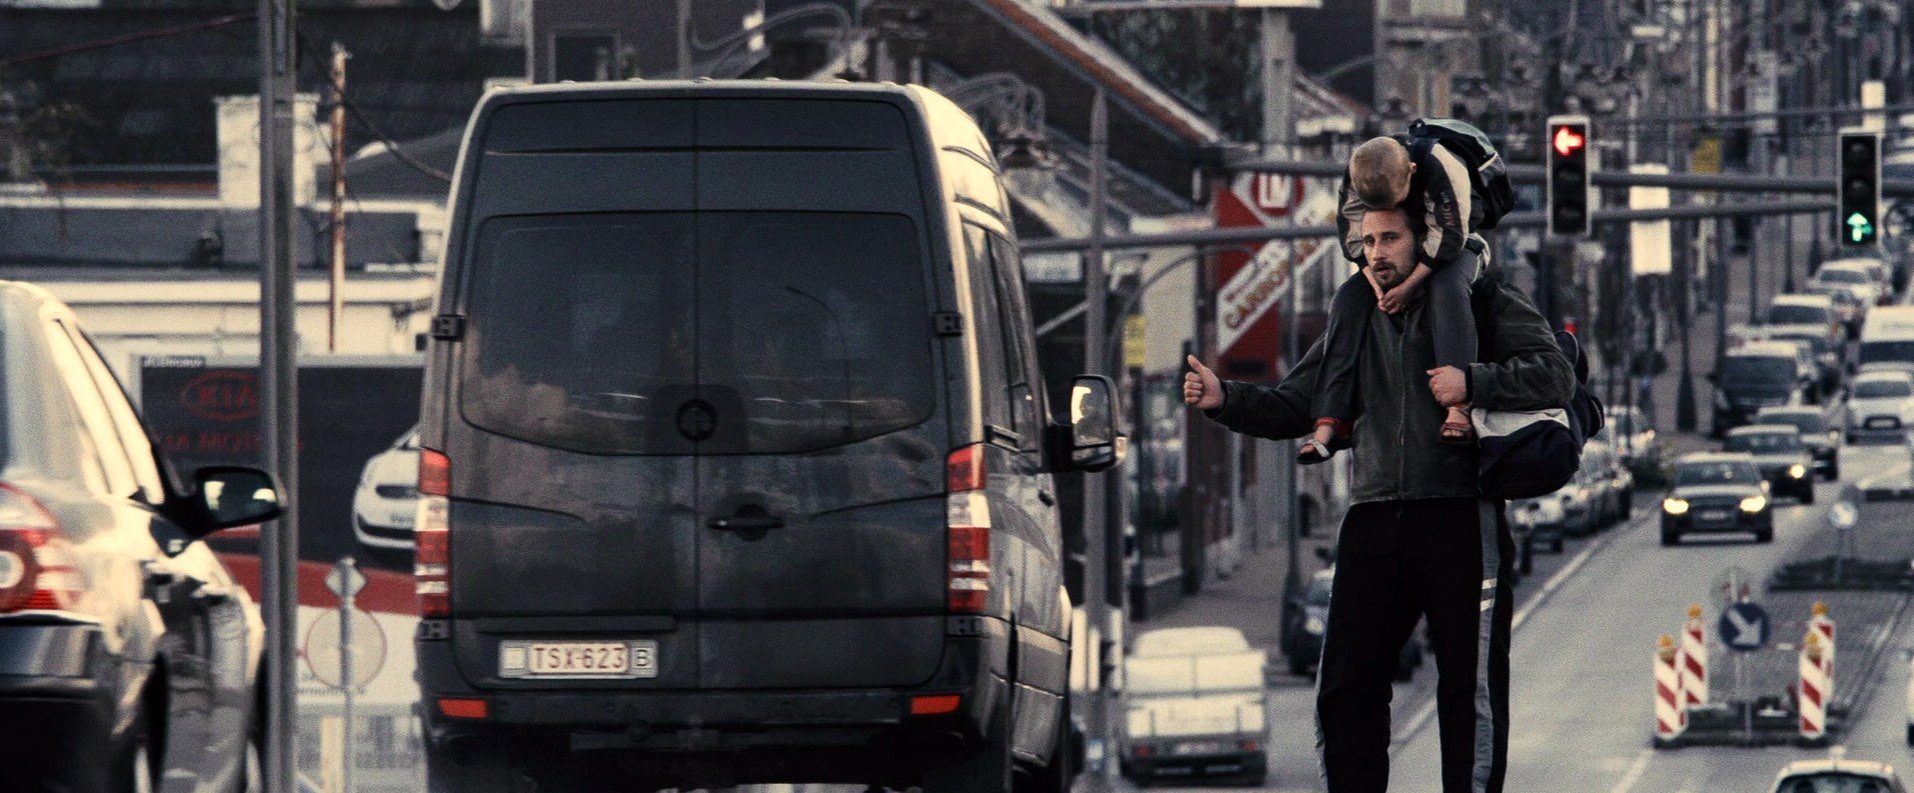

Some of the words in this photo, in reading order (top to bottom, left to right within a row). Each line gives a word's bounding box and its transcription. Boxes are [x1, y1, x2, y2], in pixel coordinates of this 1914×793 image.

[197, 384, 257, 409] KIA
[532, 646, 625, 669] TSX-623
[635, 648, 651, 667] B
